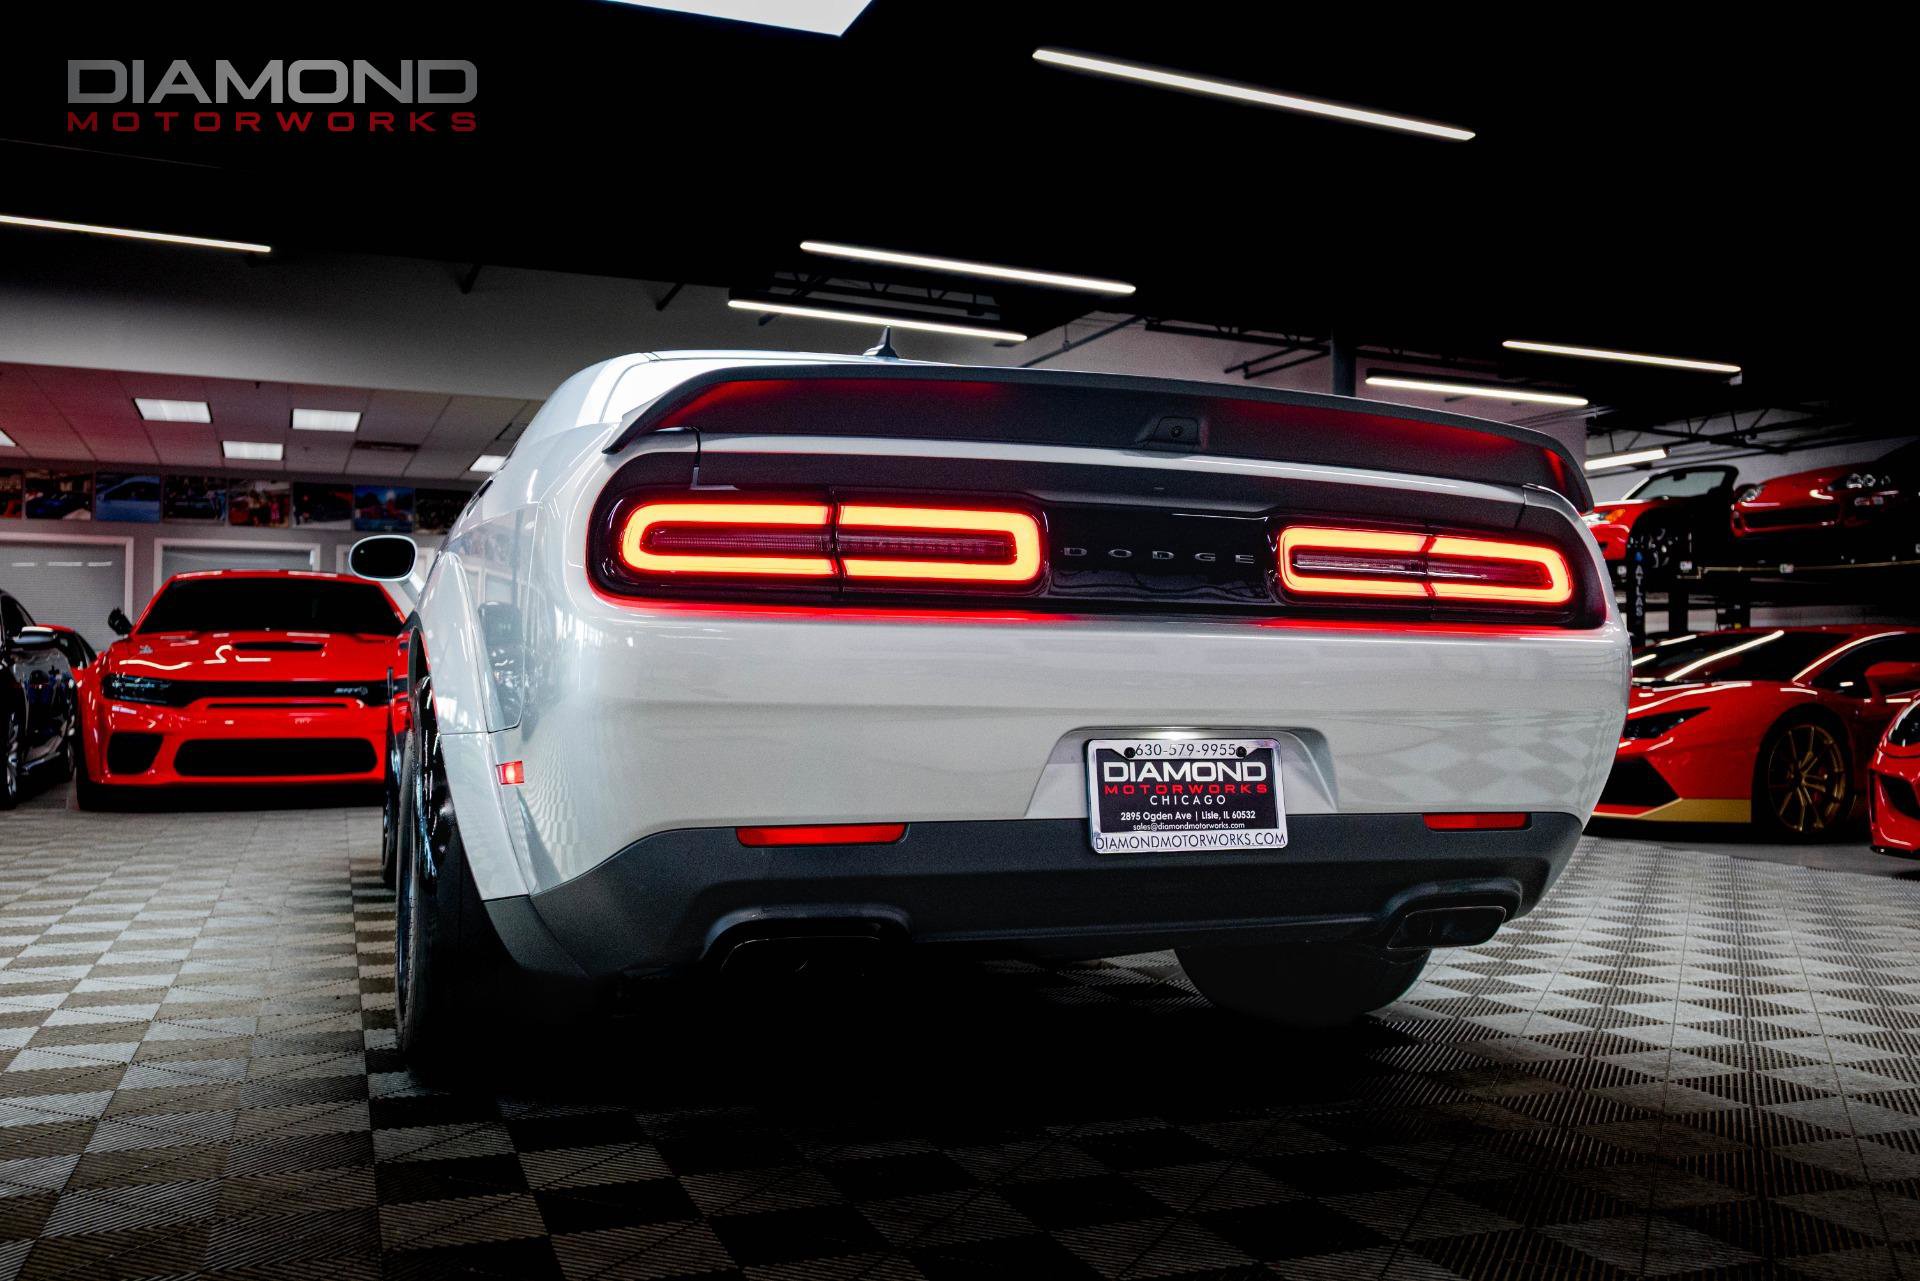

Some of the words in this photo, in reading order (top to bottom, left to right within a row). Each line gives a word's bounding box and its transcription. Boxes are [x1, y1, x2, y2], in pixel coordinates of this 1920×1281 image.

[1063, 547, 1255, 564] DODGE
[1135, 743, 1236, 757] 630-579-9955
[1103, 761, 1267, 782] DIAMOND
[1104, 783, 1269, 795] MOTORWORKS
[1149, 795, 1226, 805] CHICAGO
[1120, 812, 1141, 821] 2895
[1142, 811, 1173, 822] Ogden
[1174, 812, 1192, 820] Ave
[1201, 811, 1222, 821] Lisle,
[1223, 811, 1231, 820] IL
[1231, 810, 1256, 820] 60532
[1132, 821, 1245, 831] sales@diamondmotorworks.com
[1095, 832, 1286, 850] DIAMONDMOTORWORKS.COM
